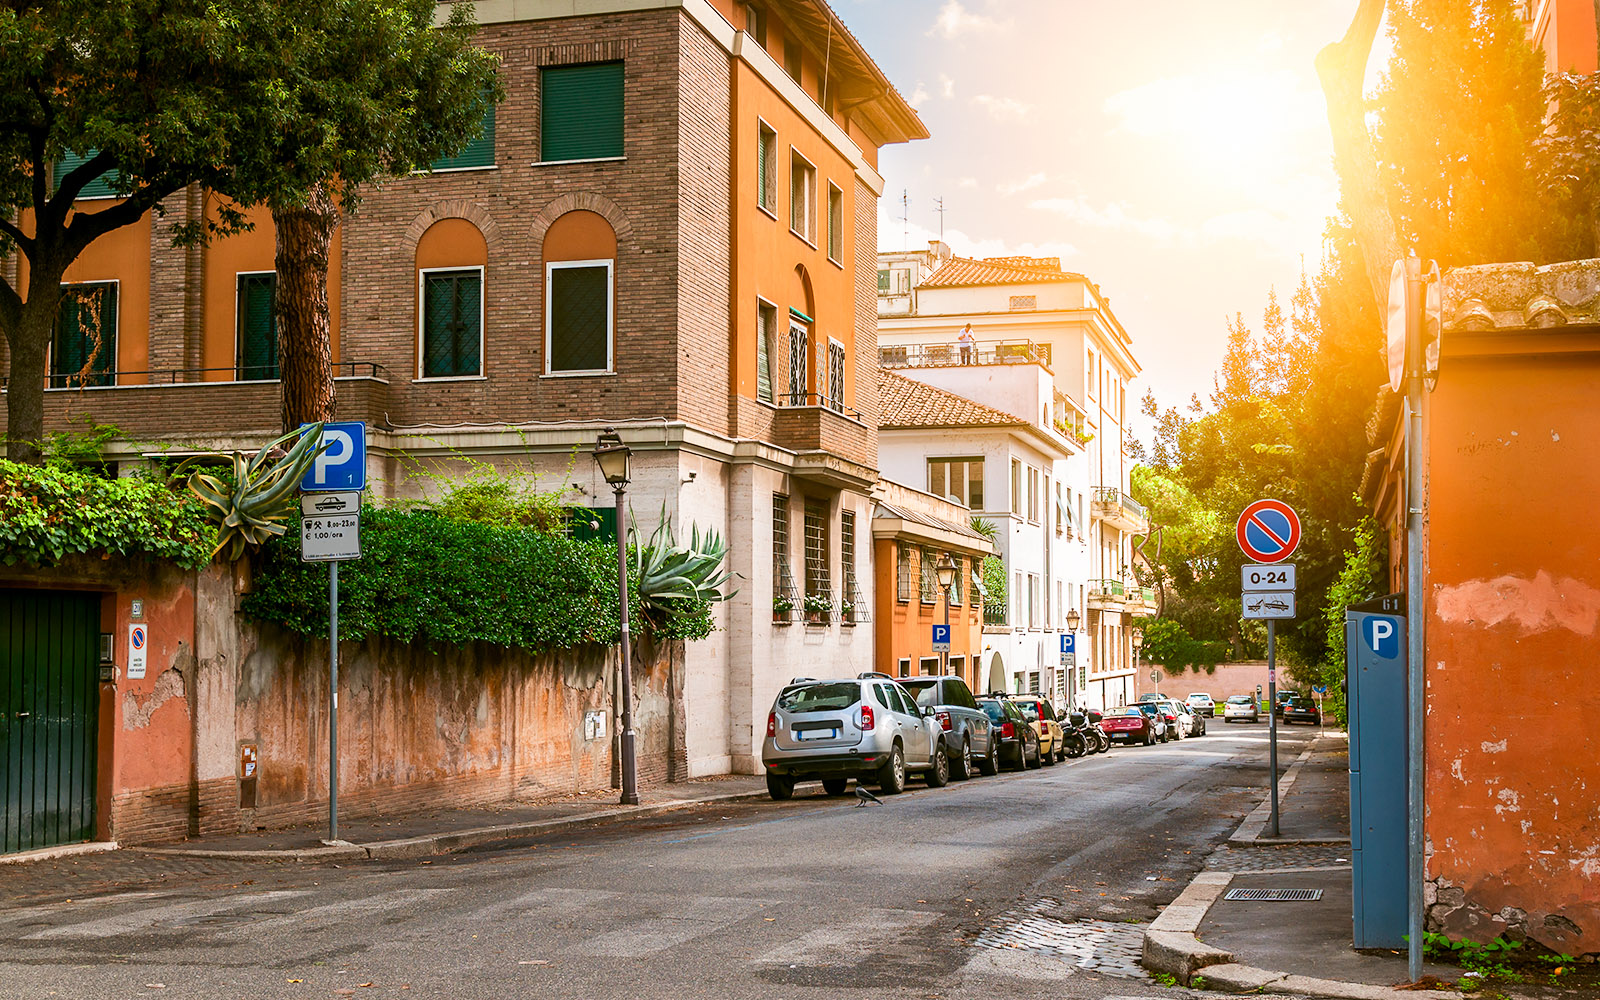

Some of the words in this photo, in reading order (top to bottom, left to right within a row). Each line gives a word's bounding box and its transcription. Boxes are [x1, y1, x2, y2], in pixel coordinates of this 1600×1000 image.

[315, 430, 353, 484] P
[347, 473, 353, 484] 1
[1250, 572, 1287, 584] 0-24
[936, 627, 947, 640] P
[1372, 620, 1393, 651] P
[1063, 636, 1073, 651] P
